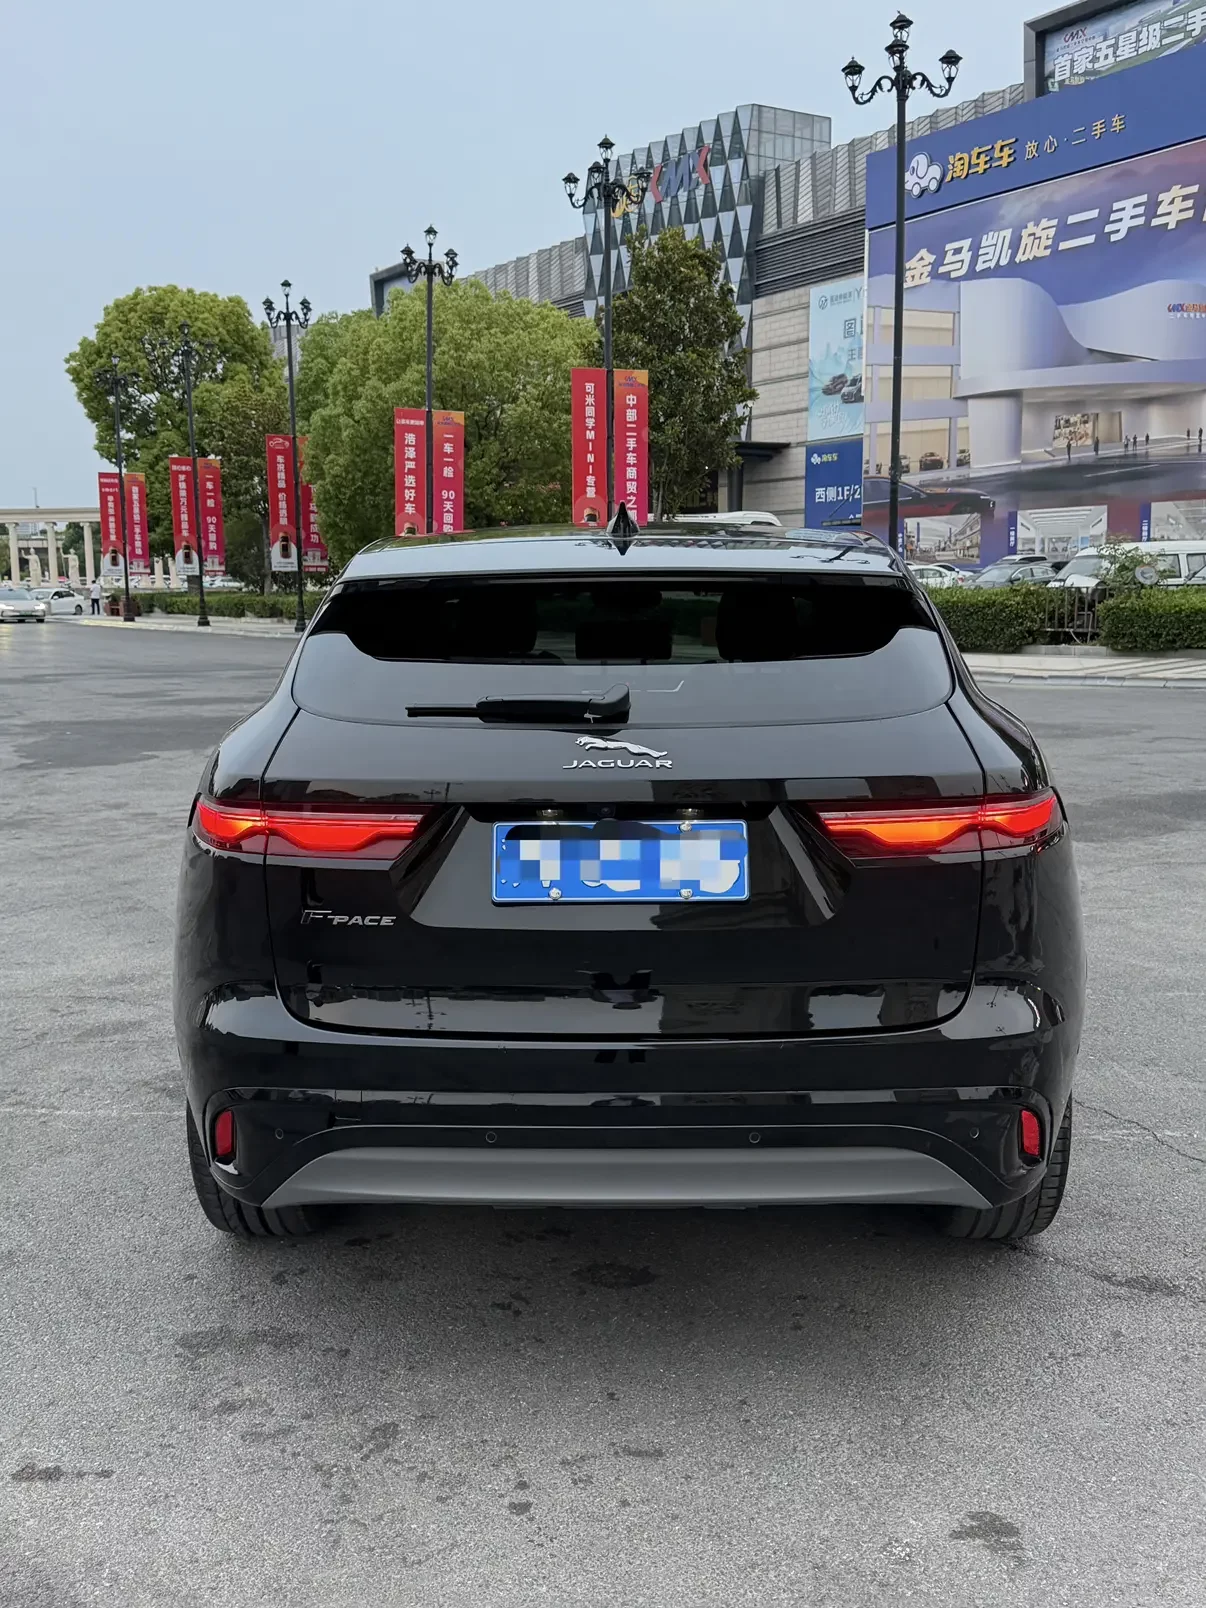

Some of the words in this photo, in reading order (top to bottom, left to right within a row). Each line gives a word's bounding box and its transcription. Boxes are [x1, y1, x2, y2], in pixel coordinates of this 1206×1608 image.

[945, 137, 1019, 183] 淘车车
[903, 184, 1206, 289] 金马凯旋二手车
[584, 382, 596, 498] 可米同学MINI专营
[563, 759, 673, 770] JAGUAR
